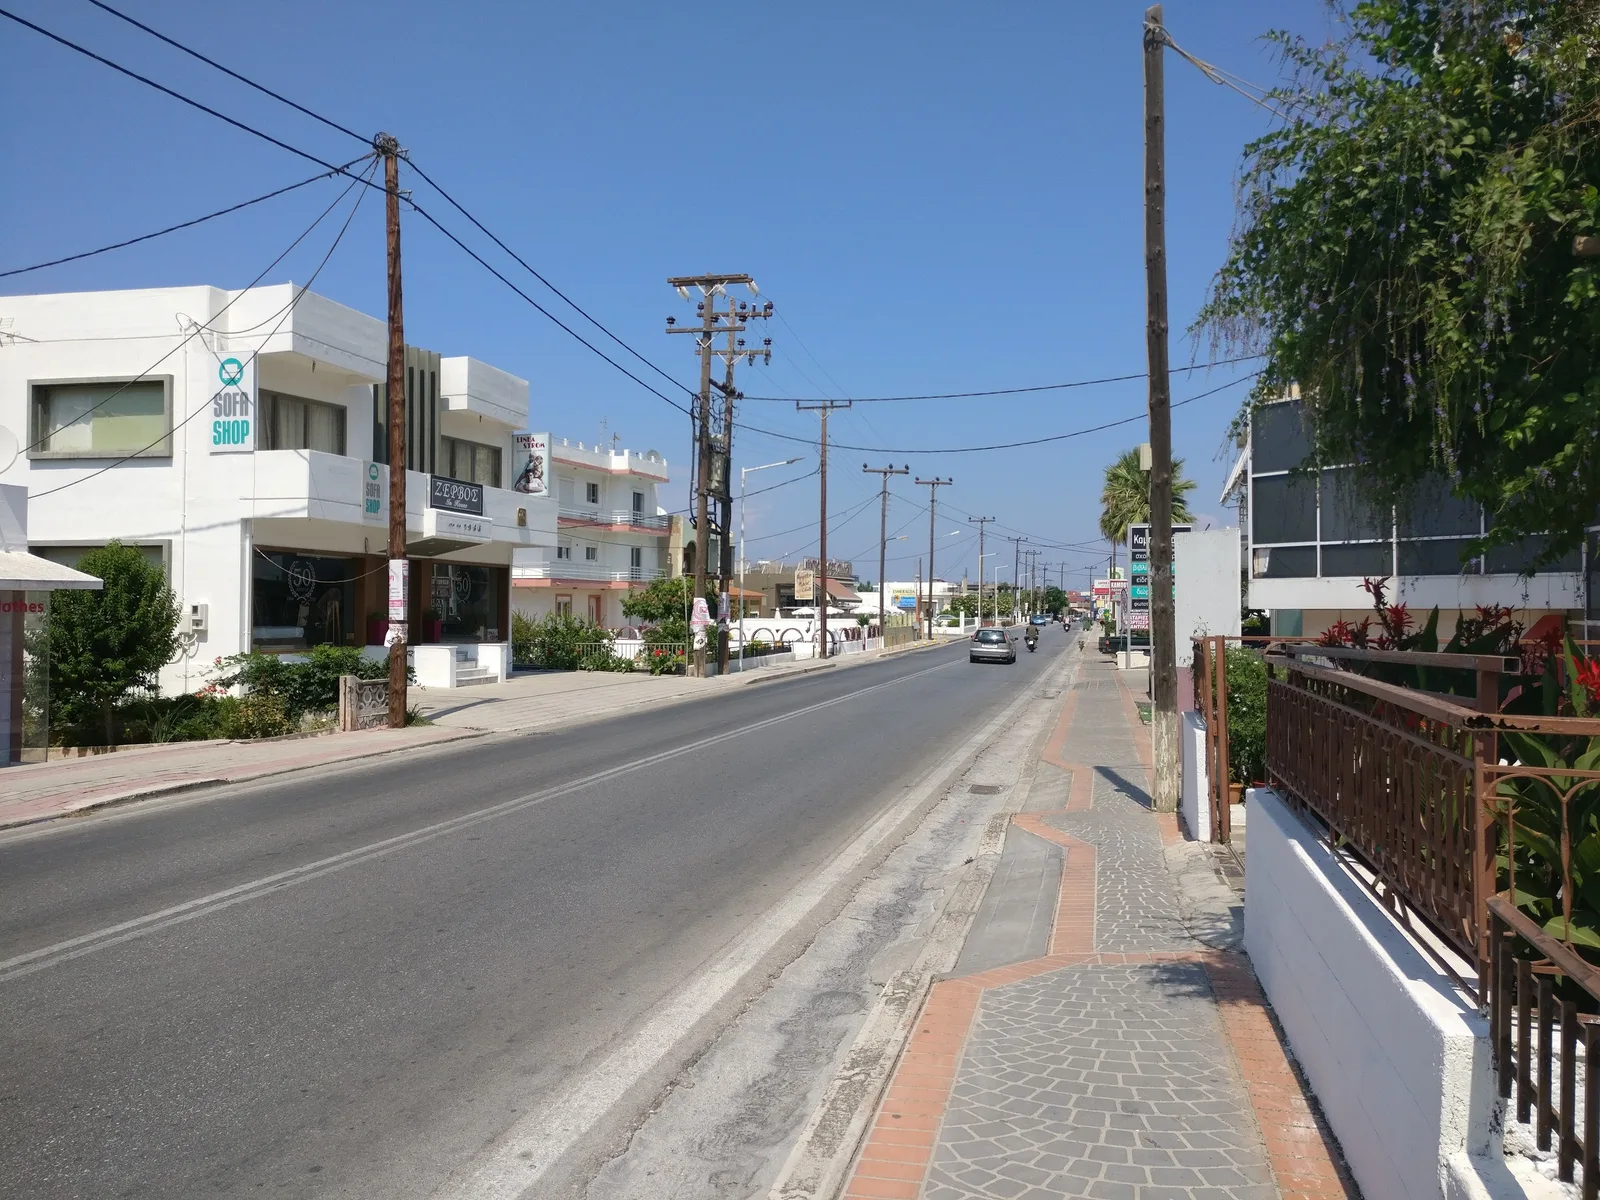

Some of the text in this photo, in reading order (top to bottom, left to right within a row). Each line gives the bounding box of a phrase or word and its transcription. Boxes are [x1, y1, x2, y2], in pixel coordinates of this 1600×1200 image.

[213, 391, 249, 418] SOFA
[212, 419, 250, 445] SHOP
[365, 482, 381, 498] SOFA
[434, 481, 479, 502] ΖΕΡΒΟΣ
[365, 498, 381, 514] SHOP
